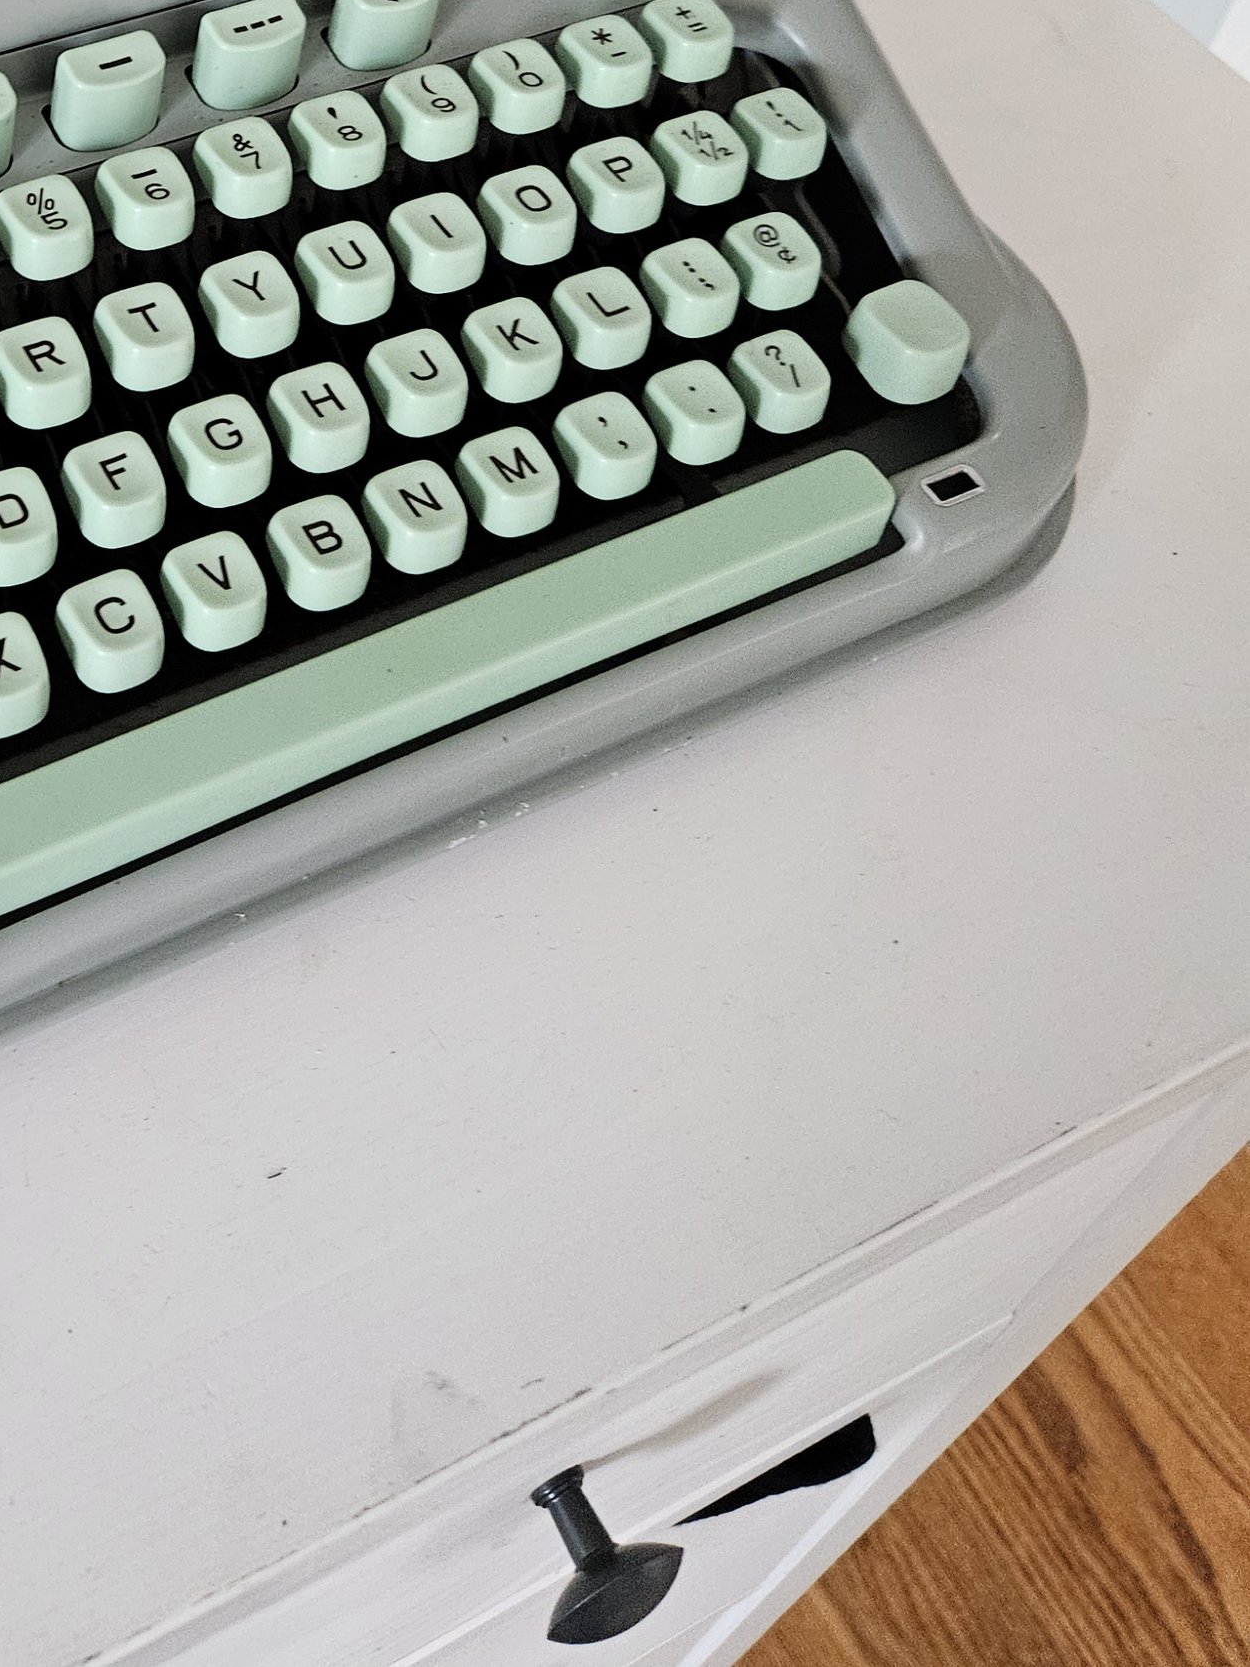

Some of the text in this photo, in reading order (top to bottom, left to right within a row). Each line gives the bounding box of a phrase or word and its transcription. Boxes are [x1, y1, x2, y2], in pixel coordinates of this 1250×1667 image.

[431, 98, 456, 112] 9
[233, 134, 253, 151] &
[337, 126, 363, 141] 8
[240, 151, 261, 169] 7
[602, 156, 632, 182] P
[27, 188, 58, 218] %
[145, 183, 170, 200] 6
[515, 185, 552, 212] O
[41, 211, 68, 230] 5
[430, 215, 454, 238] I
[754, 224, 780, 247] @
[328, 240, 367, 270] U
[232, 271, 265, 301] Y
[127, 302, 159, 332] T
[587, 292, 630, 317] L
[496, 319, 539, 351] K
[22, 340, 66, 372] R
[410, 350, 438, 381] J
[765, 345, 786, 366] ?
[301, 383, 346, 418] H
[204, 418, 243, 450] G
[99, 453, 127, 490] F
[489, 447, 538, 483] M
[398, 482, 443, 517] N
[302, 521, 343, 555] B
[197, 556, 231, 590] V
[94, 597, 135, 634] C
